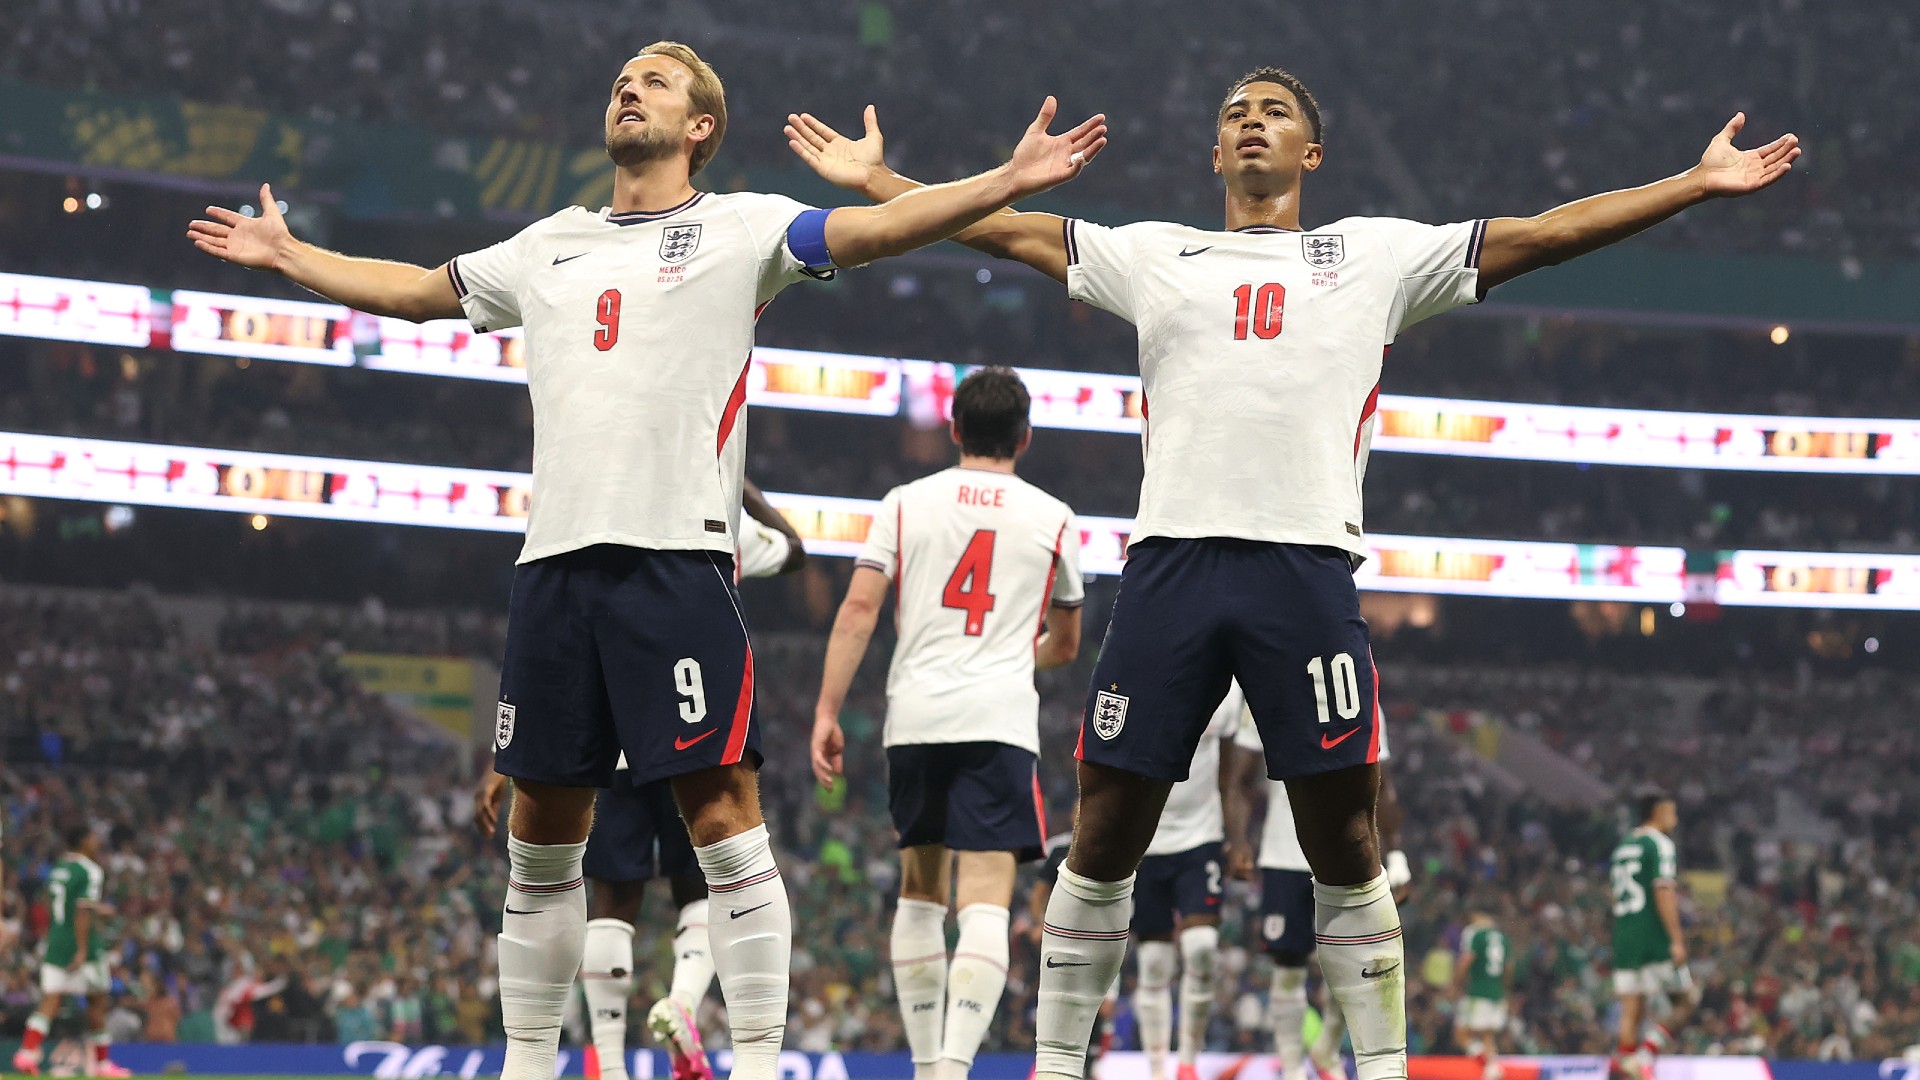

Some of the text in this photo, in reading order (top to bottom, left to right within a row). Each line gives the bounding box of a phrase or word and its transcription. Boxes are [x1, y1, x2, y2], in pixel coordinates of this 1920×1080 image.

[659, 266, 687, 274] MEXICO
[594, 288, 622, 351] 9
[1233, 283, 1286, 341] 10
[958, 485, 1006, 507] RICE
[942, 529, 996, 636] 4
[673, 657, 708, 724] 9
[1306, 652, 1361, 723] 10
[1204, 860, 1222, 894] 2
